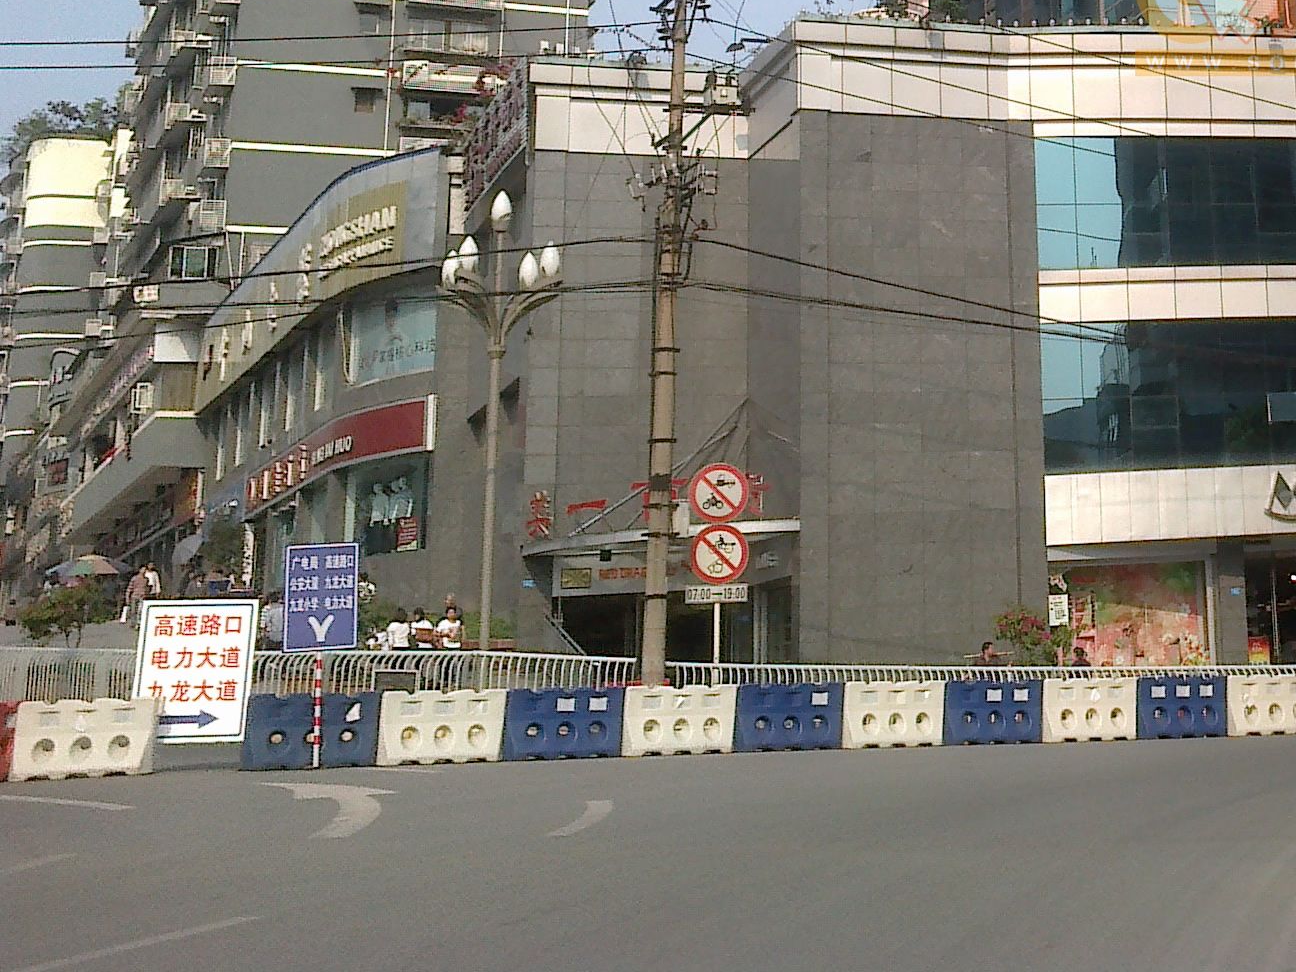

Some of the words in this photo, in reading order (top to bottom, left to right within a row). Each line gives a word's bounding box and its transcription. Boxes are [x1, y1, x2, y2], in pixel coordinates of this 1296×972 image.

[153, 613, 243, 637] 高速路口
[149, 646, 241, 669] 电力大道
[147, 678, 239, 703] 九龙大道
